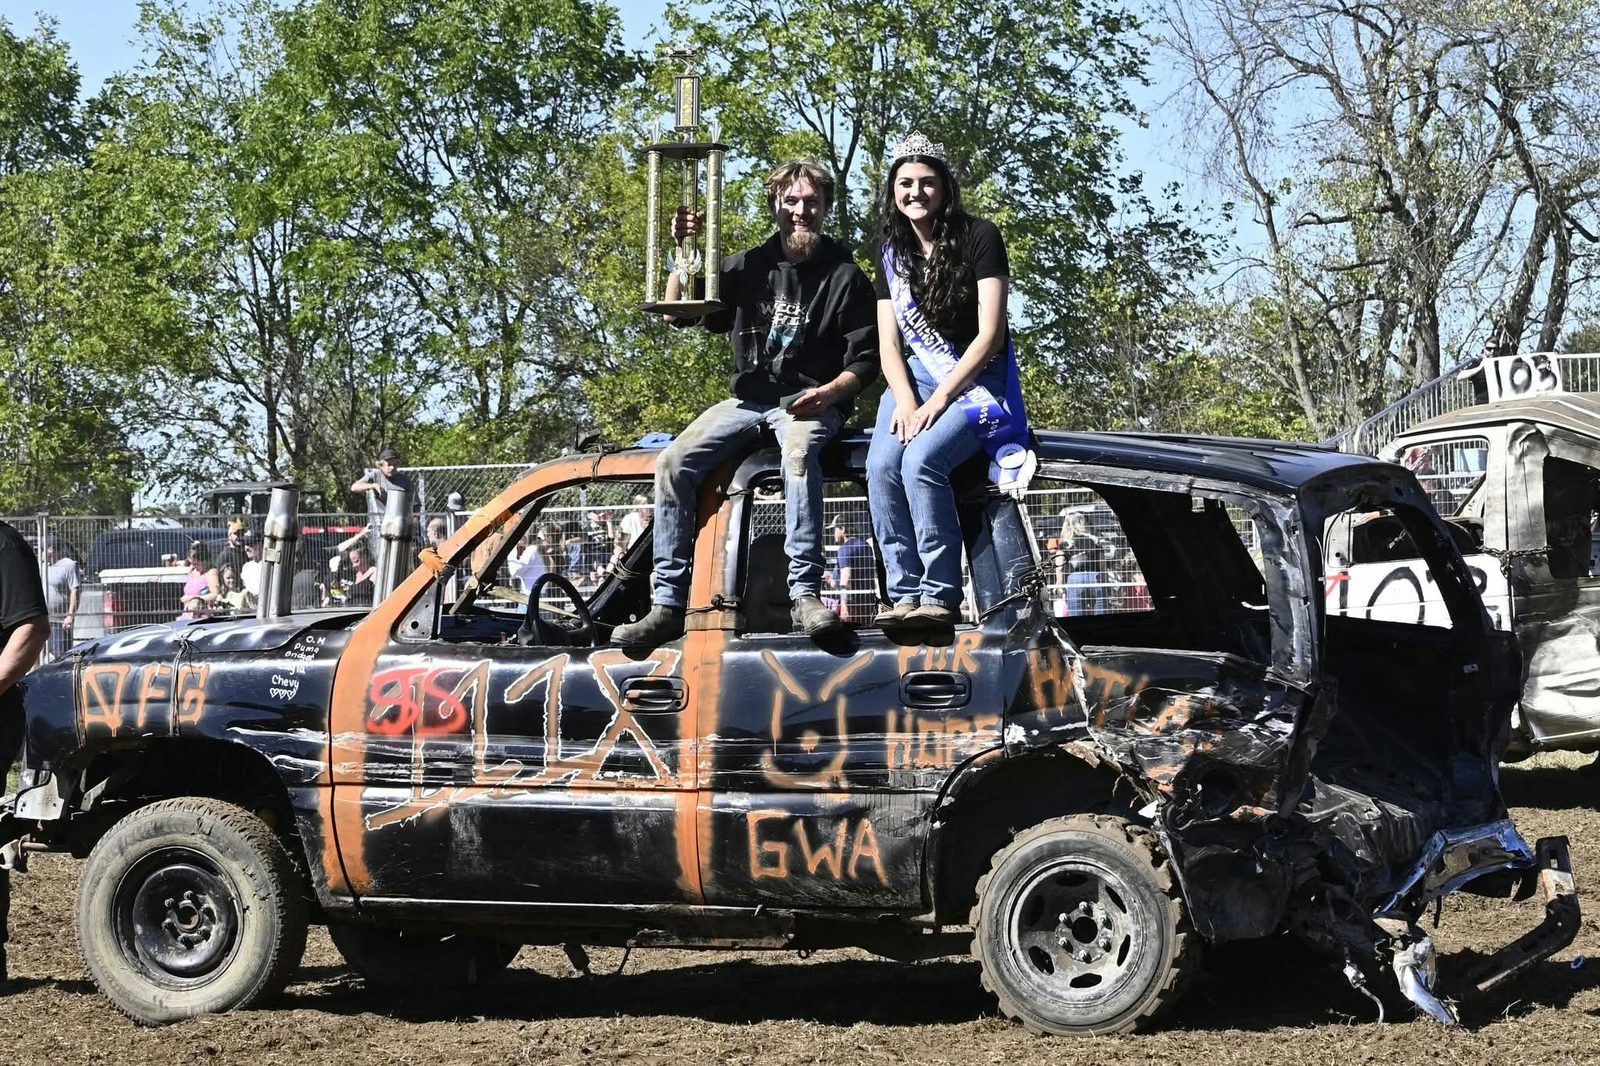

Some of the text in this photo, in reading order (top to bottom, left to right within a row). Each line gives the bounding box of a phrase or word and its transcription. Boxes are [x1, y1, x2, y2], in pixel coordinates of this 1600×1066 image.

[1494, 354, 1559, 398] 103
[271, 674, 300, 692] Chevy
[747, 811, 891, 887] GWA
